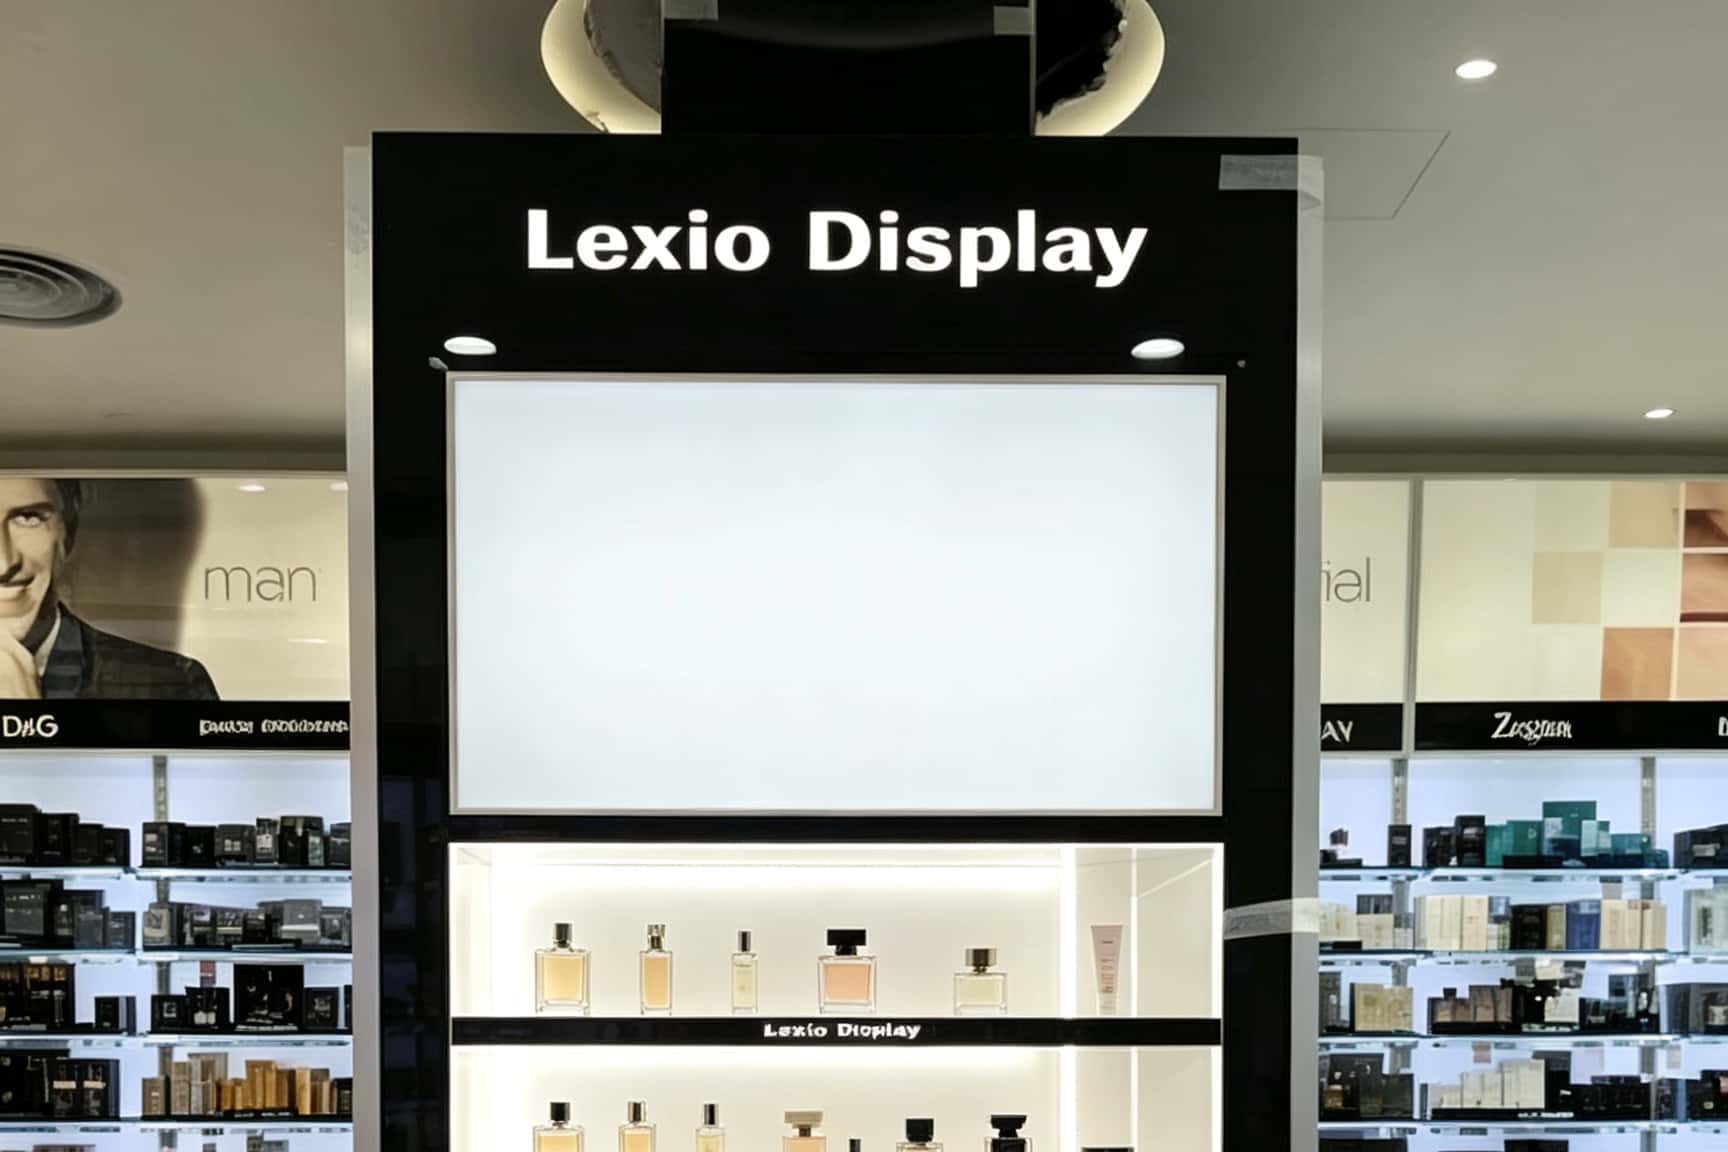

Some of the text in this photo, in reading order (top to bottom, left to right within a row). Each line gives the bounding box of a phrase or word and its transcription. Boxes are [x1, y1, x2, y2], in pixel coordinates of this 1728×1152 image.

[526, 208, 1149, 288] Lexio Display
[204, 566, 317, 602] man
